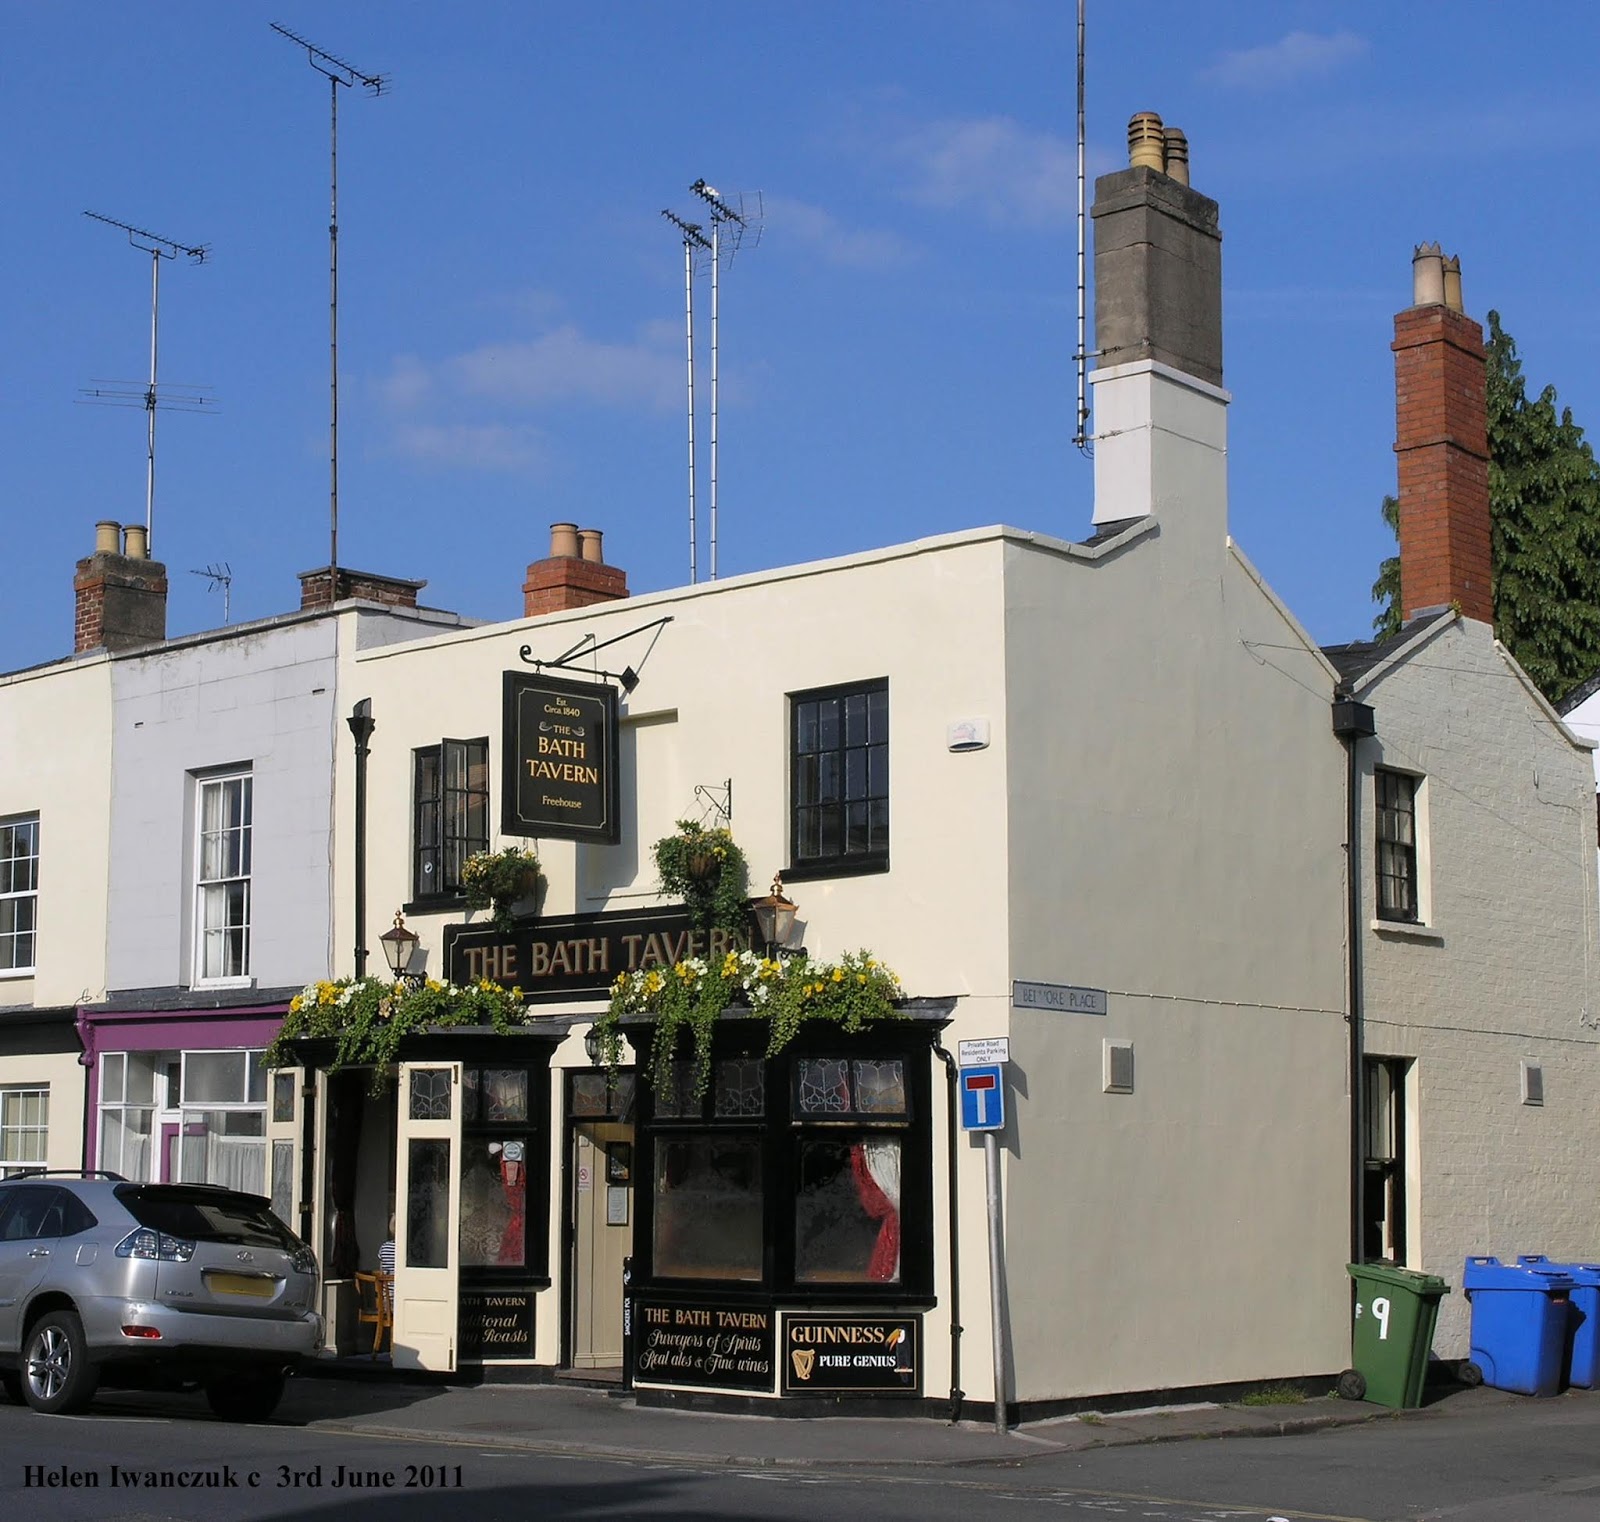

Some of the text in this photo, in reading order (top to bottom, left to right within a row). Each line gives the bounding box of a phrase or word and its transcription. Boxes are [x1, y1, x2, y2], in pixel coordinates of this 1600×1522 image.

[563, 707, 580, 717] 1840
[553, 724, 571, 735] THE
[538, 736, 585, 759] BATH
[526, 759, 598, 784] TAVERN
[542, 795, 582, 808] Freehouse
[463, 944, 518, 980] THE
[531, 937, 611, 976] BATH
[1069, 992, 1097, 1009] PLACE
[967, 1041, 986, 1049] Private
[484, 1297, 526, 1306] TAVERN
[644, 1308, 767, 1329] THE BATH TAVERN
[1371, 1297, 1390, 1340] 9
[482, 1328, 528, 1343] Roasts
[791, 1326, 885, 1344] GUINNESS
[706, 1333, 721, 1356] of
[721, 1333, 761, 1355] Spirits
[639, 1349, 769, 1375] Real ales & Fine wines
[819, 1355, 896, 1367] PURE GENIUS
